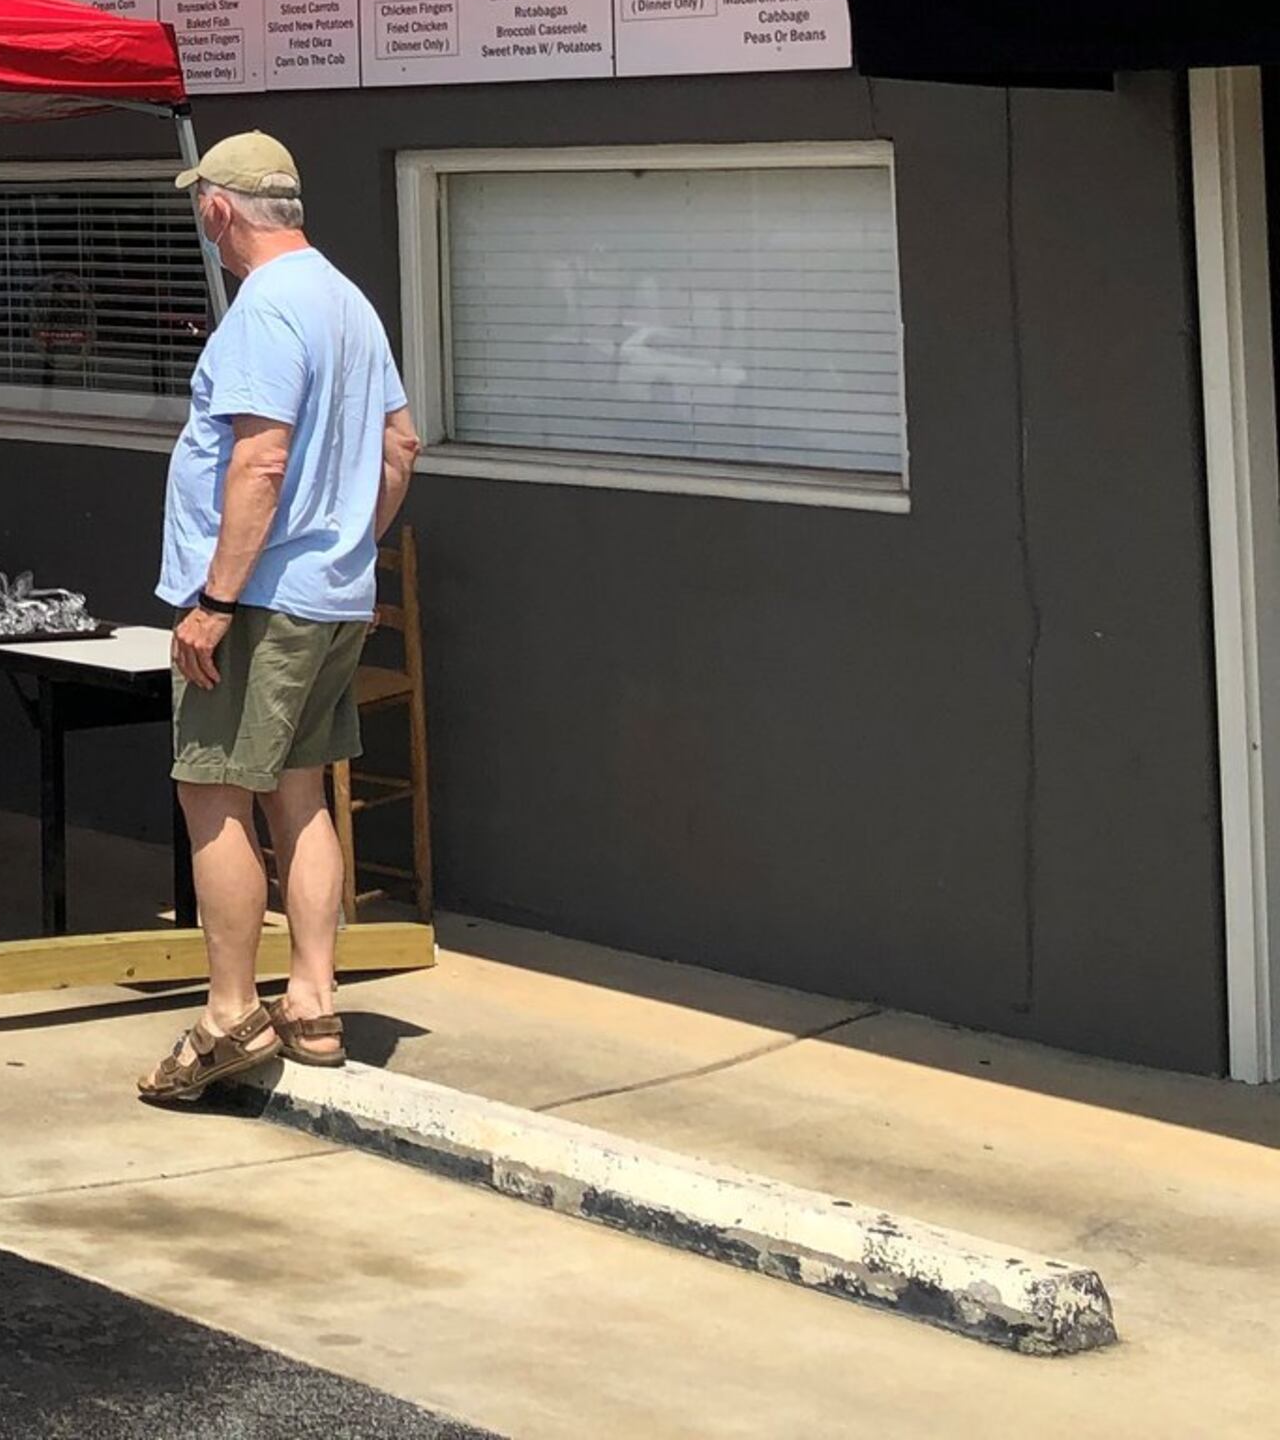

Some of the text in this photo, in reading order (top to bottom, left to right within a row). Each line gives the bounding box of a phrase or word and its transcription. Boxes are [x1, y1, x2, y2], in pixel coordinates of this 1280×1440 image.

[381, 1, 453, 17] Chicken Fingers
[514, 5, 568, 19] Rutabagas
[758, 10, 810, 25] Cabbage
[387, 20, 448, 34] Fried Chicken
[496, 22, 588, 38] Broccoli Casserole
[744, 27, 827, 45] Peas Or Beans
